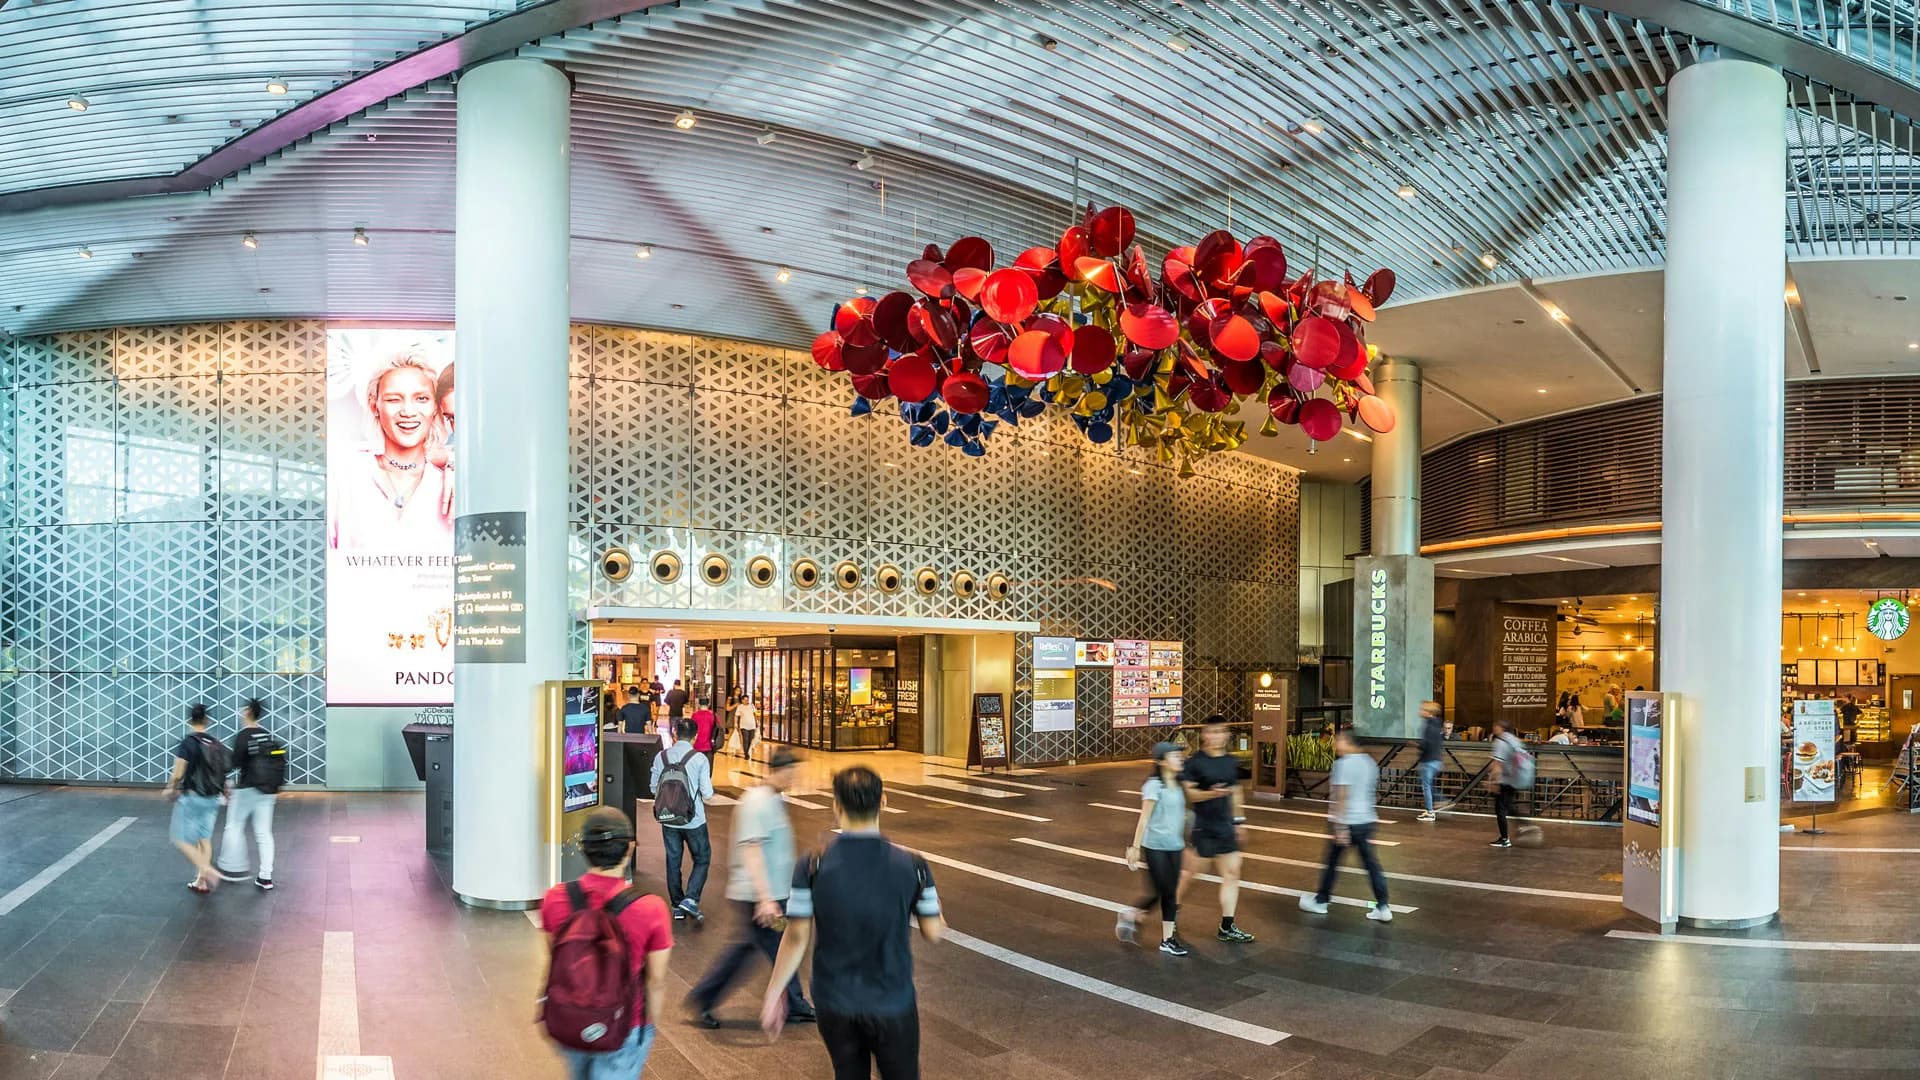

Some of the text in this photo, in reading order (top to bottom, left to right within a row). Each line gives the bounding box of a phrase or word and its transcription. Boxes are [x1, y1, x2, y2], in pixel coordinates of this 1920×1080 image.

[346, 555, 423, 567] WHATEVER
[489, 562, 516, 571] Centre
[500, 624, 521, 634] Road
[1503, 619, 1548, 632] COFFEA
[1370, 569, 1387, 709] STARBUCKS
[1503, 632, 1548, 644] ARABICA
[897, 680, 918, 691] LUSH
[897, 691, 918, 701] FRESH
